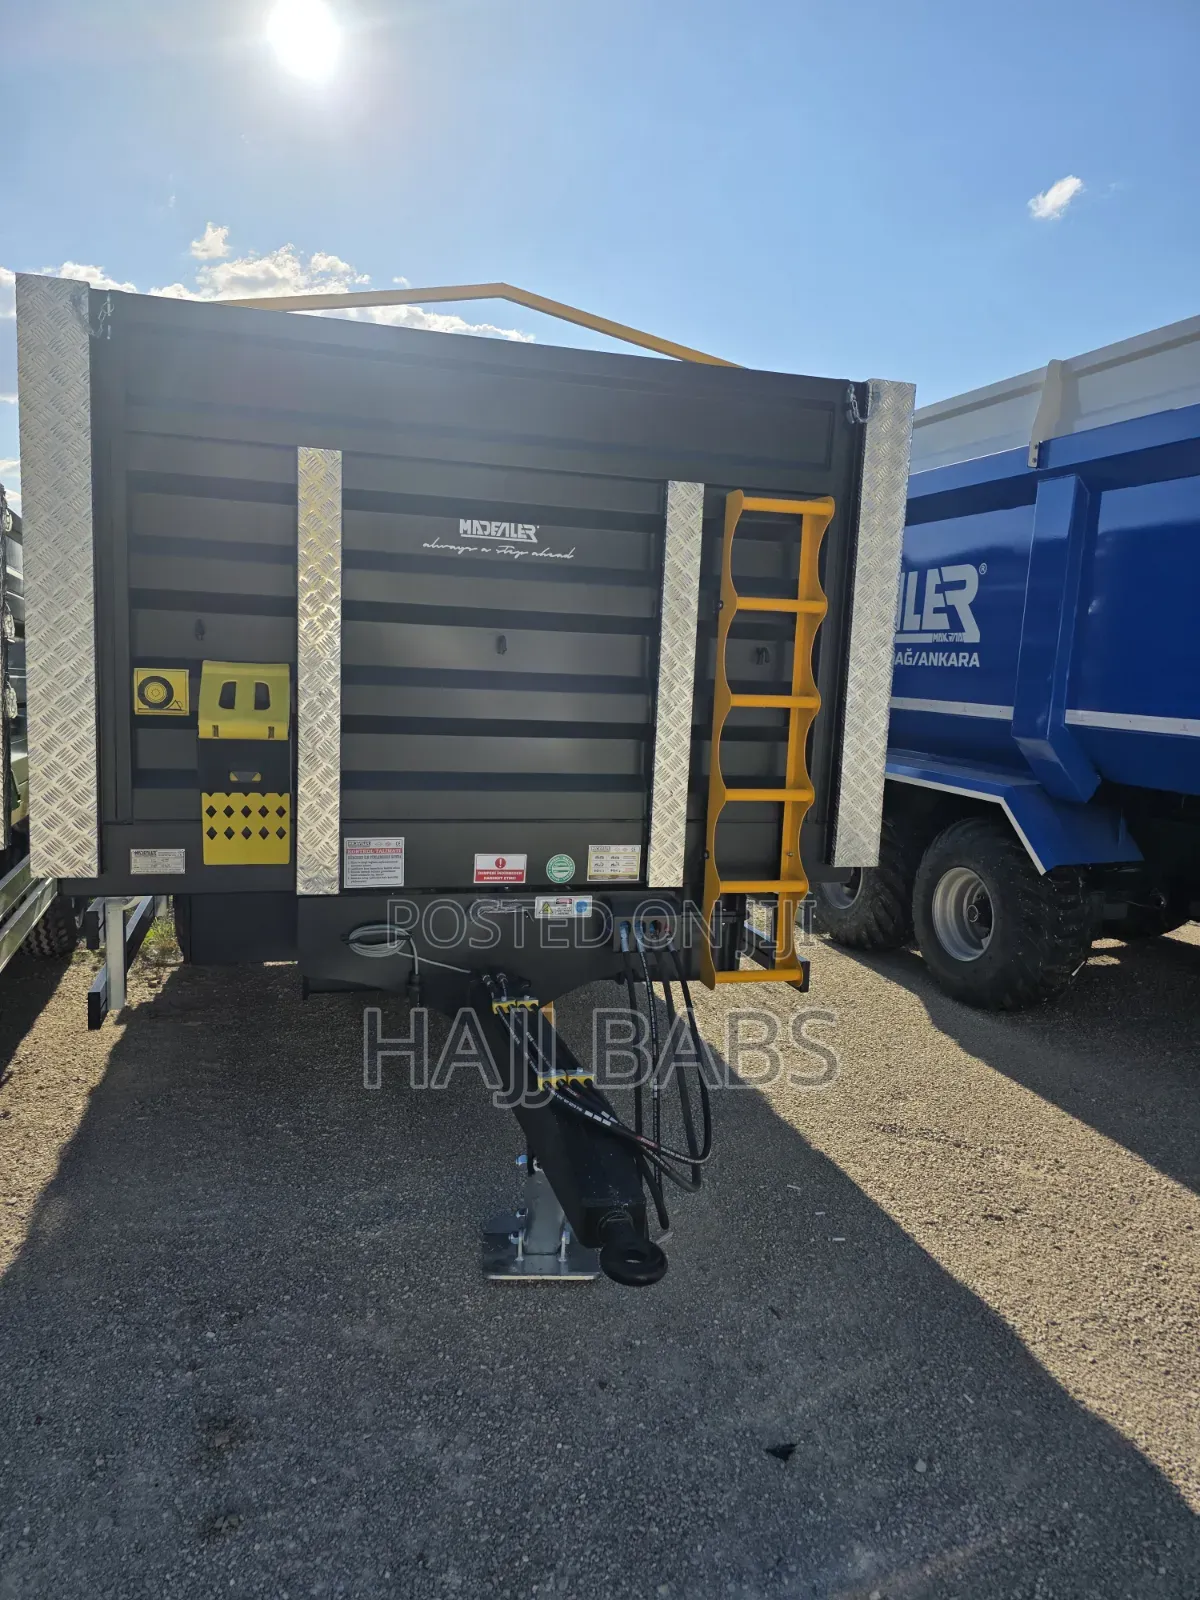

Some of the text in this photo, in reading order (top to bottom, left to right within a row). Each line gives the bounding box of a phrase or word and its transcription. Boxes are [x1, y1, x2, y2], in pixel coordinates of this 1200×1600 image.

[422, 537, 478, 555] always
[495, 545, 529, 559] step
[531, 547, 576, 559] ahead
